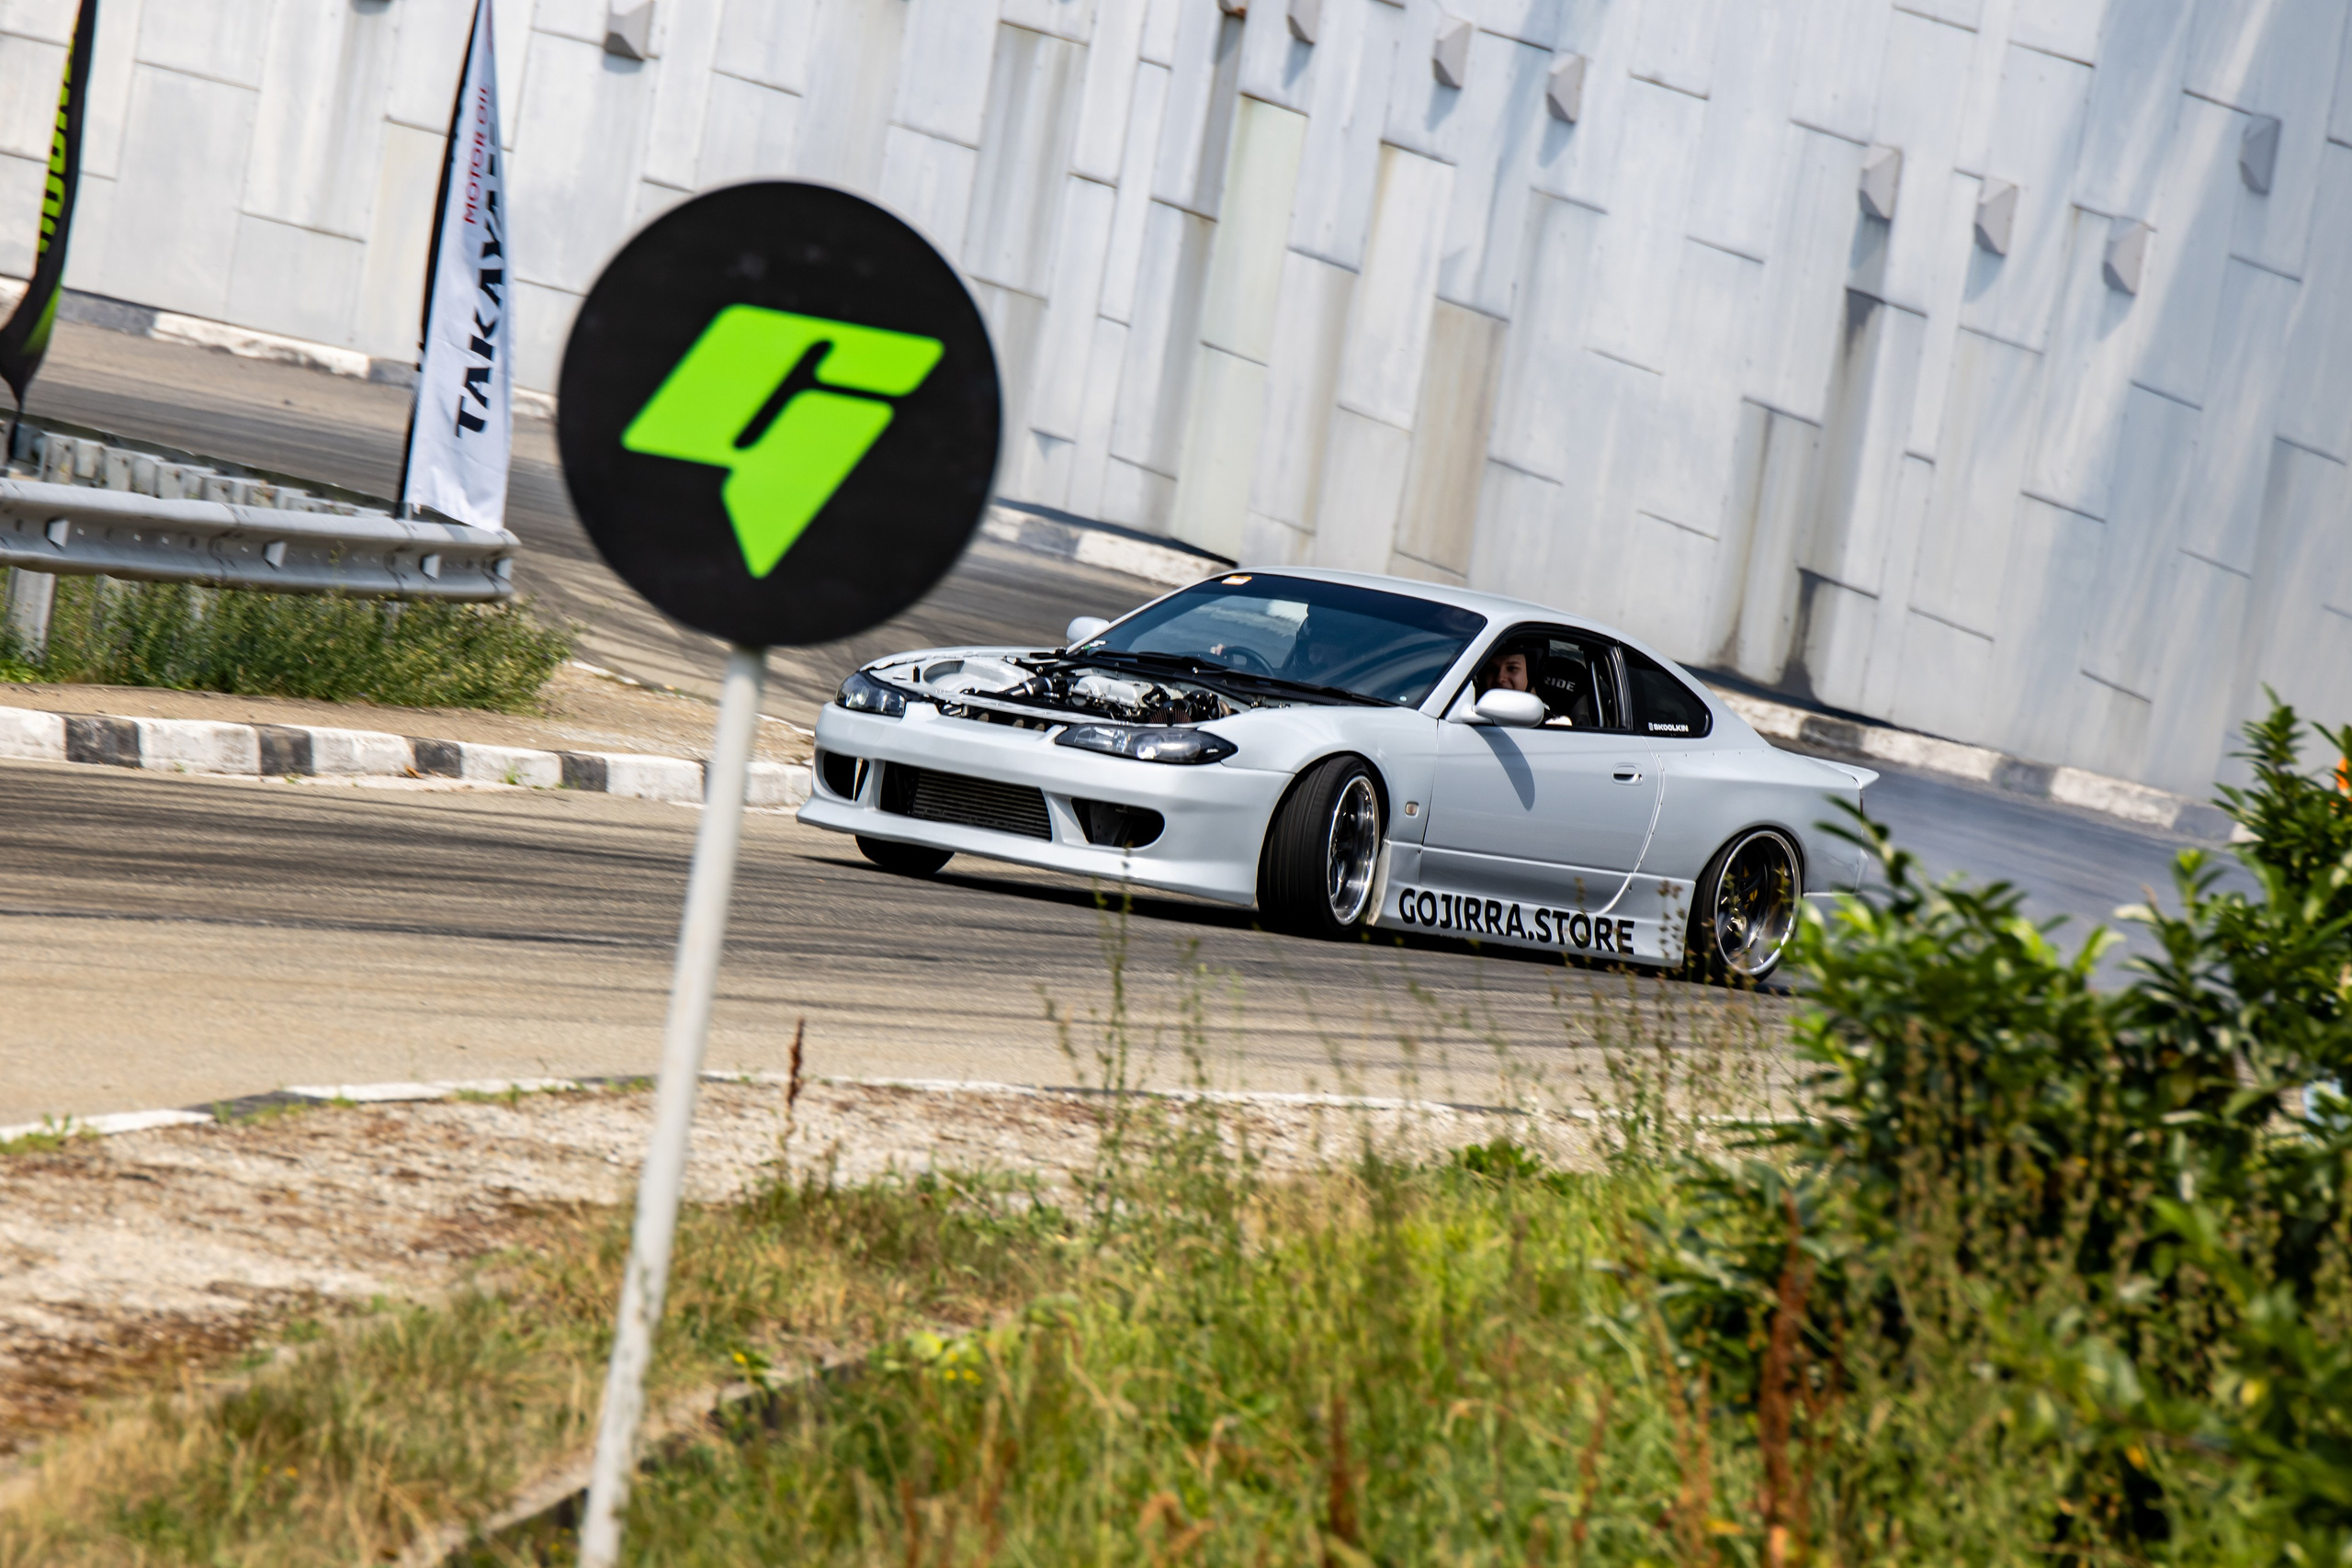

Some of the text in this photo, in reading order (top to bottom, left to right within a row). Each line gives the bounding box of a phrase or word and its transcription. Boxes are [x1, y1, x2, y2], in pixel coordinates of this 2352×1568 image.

[463, 82, 490, 225] MOTOR OIL
[454, 86, 504, 438] TAKAYA
[1398, 887, 1635, 955] GOJIRRA.STORE
